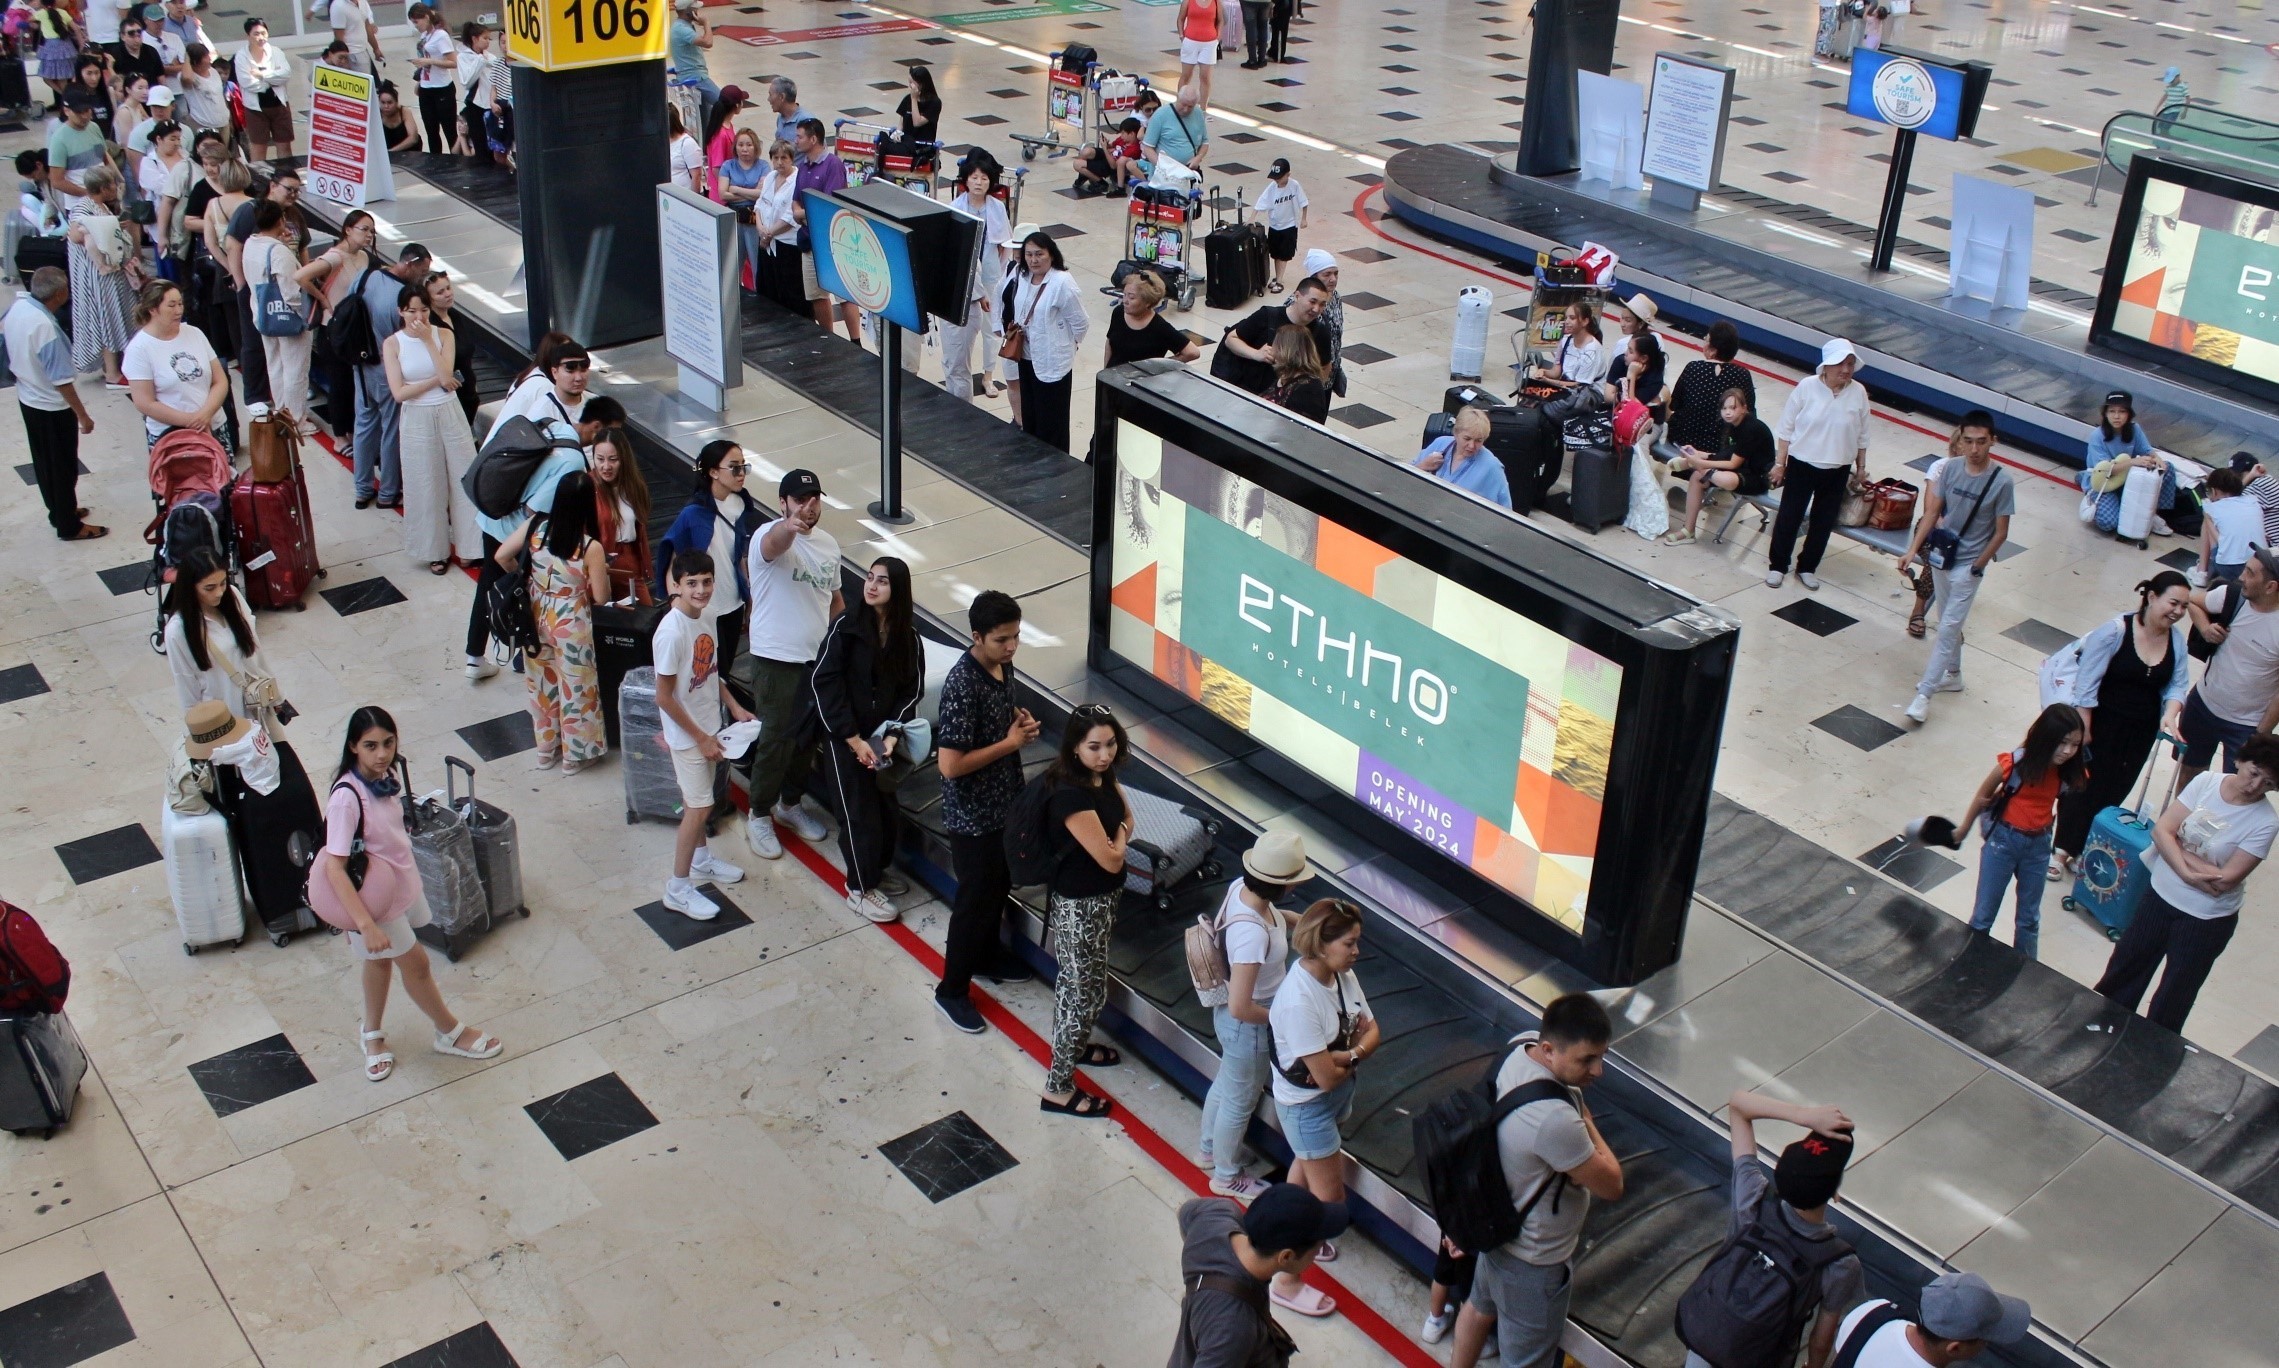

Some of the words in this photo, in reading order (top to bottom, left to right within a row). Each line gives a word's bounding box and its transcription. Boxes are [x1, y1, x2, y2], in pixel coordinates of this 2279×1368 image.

[507, 0, 541, 44] 106
[564, 0, 650, 43] 106
[331, 78, 365, 95] CAUTION
[1887, 89, 1922, 103] TOURISM
[1896, 84, 1915, 95] SAFE
[1134, 231, 1159, 248] HAVE
[1159, 239, 1182, 252] FUN!
[615, 636, 635, 644] WORLD
[1371, 770, 1452, 829] OPENING
